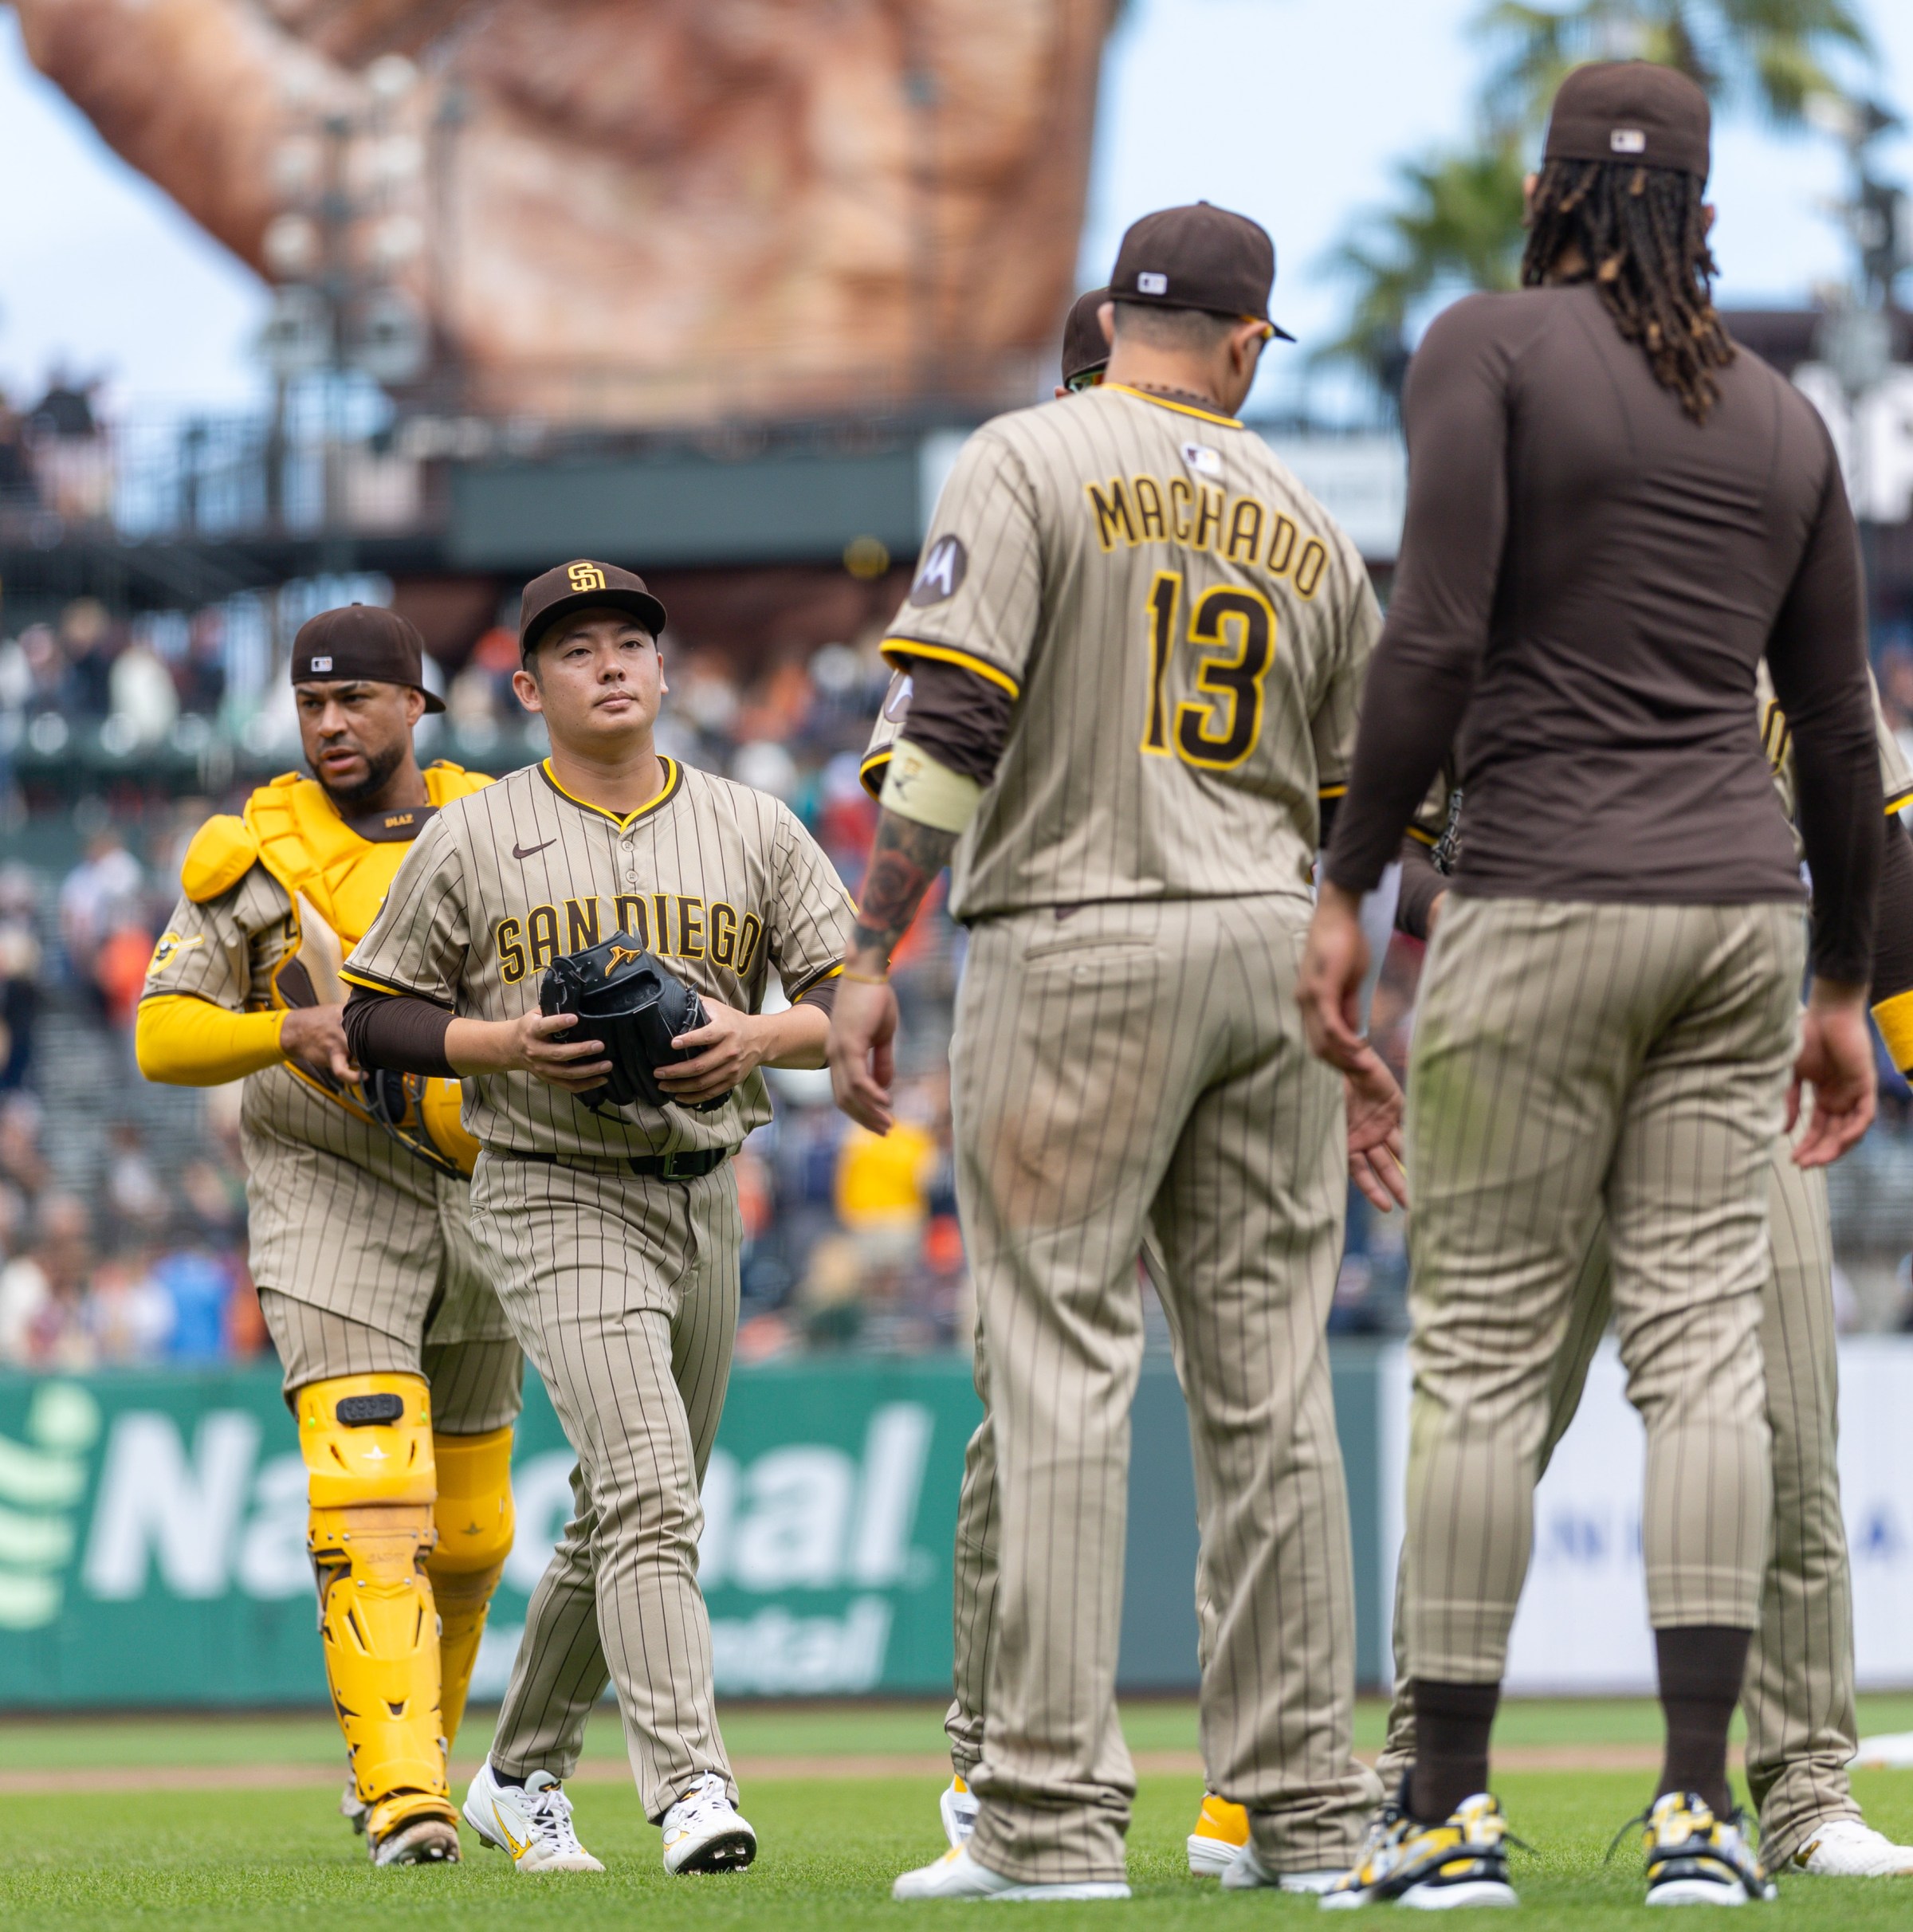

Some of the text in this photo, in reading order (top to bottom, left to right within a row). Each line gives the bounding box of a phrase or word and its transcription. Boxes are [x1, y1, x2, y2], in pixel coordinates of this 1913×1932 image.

[1086, 477, 1329, 601] MACHADO
[1140, 570, 1278, 770] 13
[385, 813, 414, 828] DIAZ
[497, 893, 760, 984] SAN DIEGO
